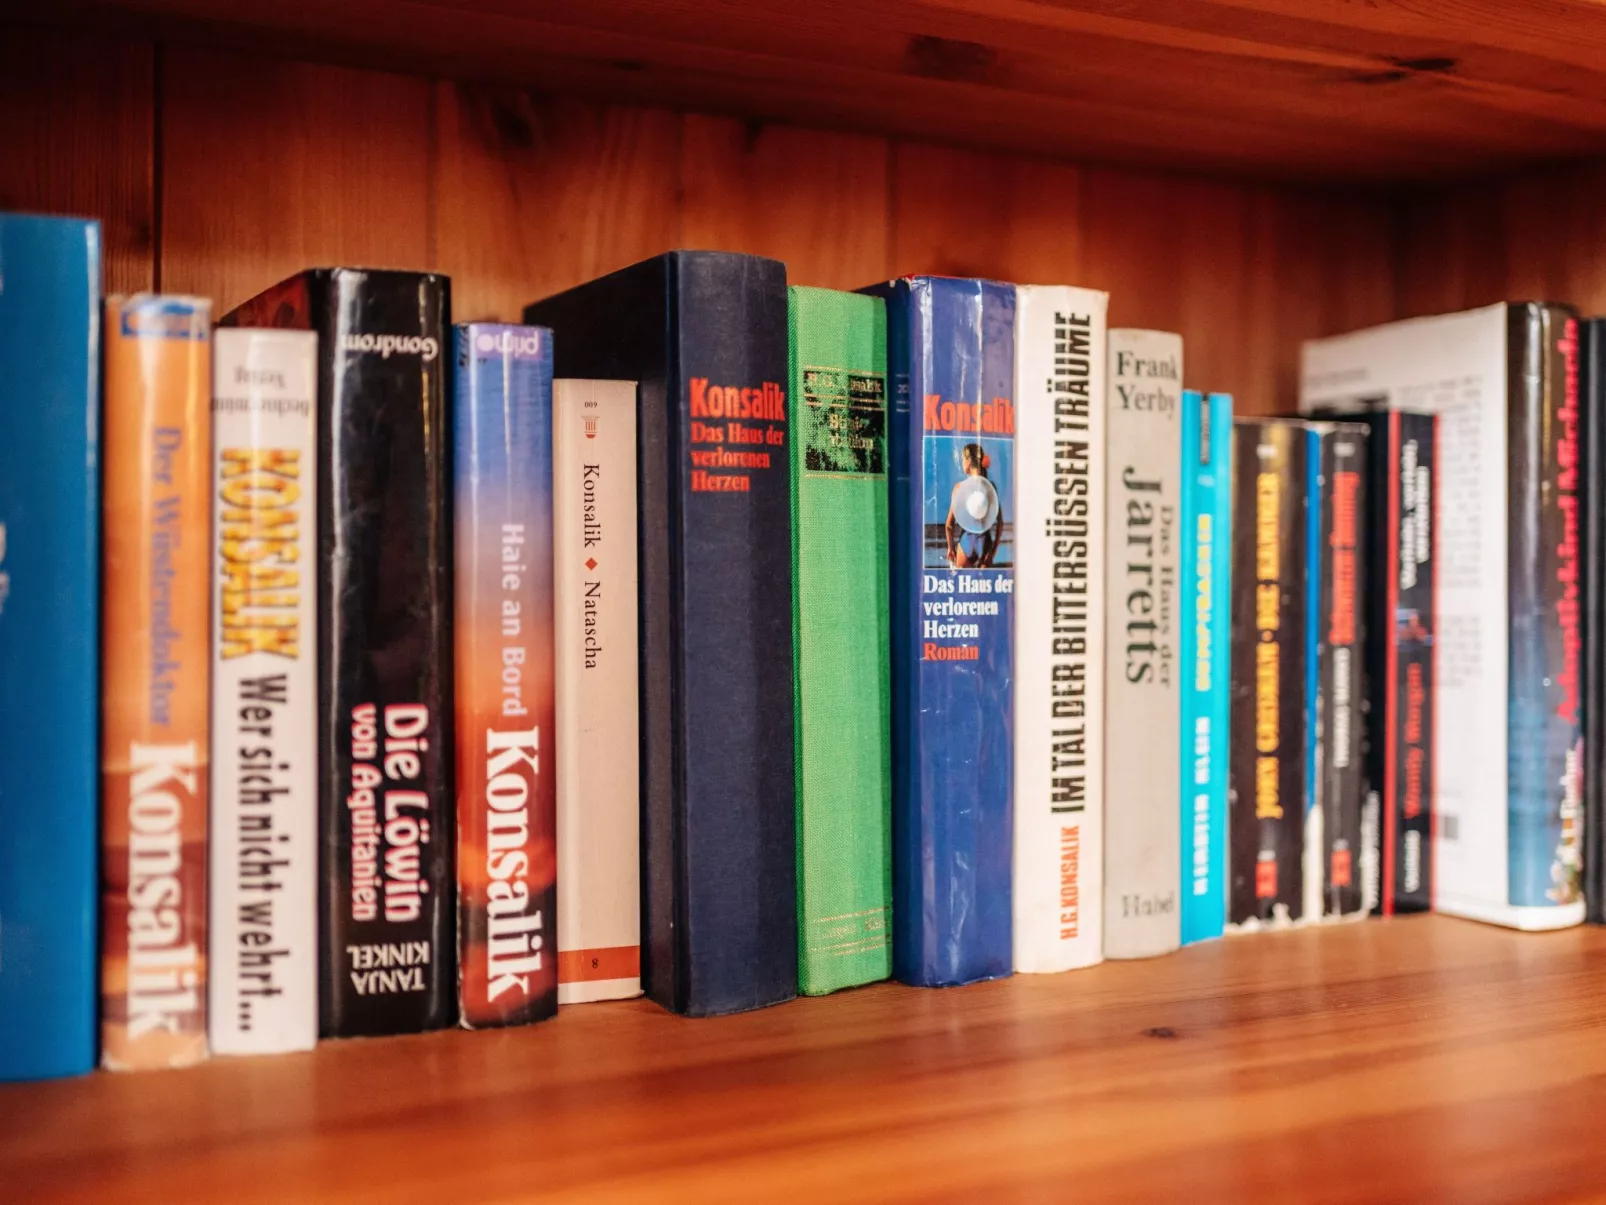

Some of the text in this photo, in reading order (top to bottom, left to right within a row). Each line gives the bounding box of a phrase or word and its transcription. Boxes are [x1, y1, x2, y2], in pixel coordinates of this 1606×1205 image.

[343, 333, 438, 361] Gondrom
[1115, 350, 1178, 381] Frank
[584, 401, 598, 409] 009
[689, 377, 786, 422] Konsalik
[923, 394, 1015, 434] Konsalik
[1115, 384, 1176, 420] Yerby
[690, 423, 785, 446] Das Haus der
[690, 447, 771, 469] verlorenen
[690, 470, 751, 492] Herzen
[219, 448, 302, 661] KONSALIK
[583, 463, 603, 670] Konsalik Natascha
[1046, 311, 1091, 814] IM TAL DER BITTERSÜSSEN TRÄUME
[1123, 466, 1164, 685] Jarretts
[149, 427, 184, 727] Der Wüstendoktor
[923, 575, 1014, 594] Das Haus der
[501, 524, 528, 717] Haie an Bord
[923, 597, 999, 616] verlorenen
[923, 619, 979, 639] Herzen
[923, 641, 980, 662] Roman
[238, 673, 288, 733] Wer
[238, 746, 291, 806] sich
[347, 703, 382, 922] von Aquitanien
[384, 702, 430, 923] Die Löwin
[238, 815, 291, 890] nicht
[486, 725, 543, 1003] Konsalik
[127, 740, 199, 1038] Konsalik
[346, 941, 430, 969] KINKEL
[351, 970, 426, 995] TANJA
